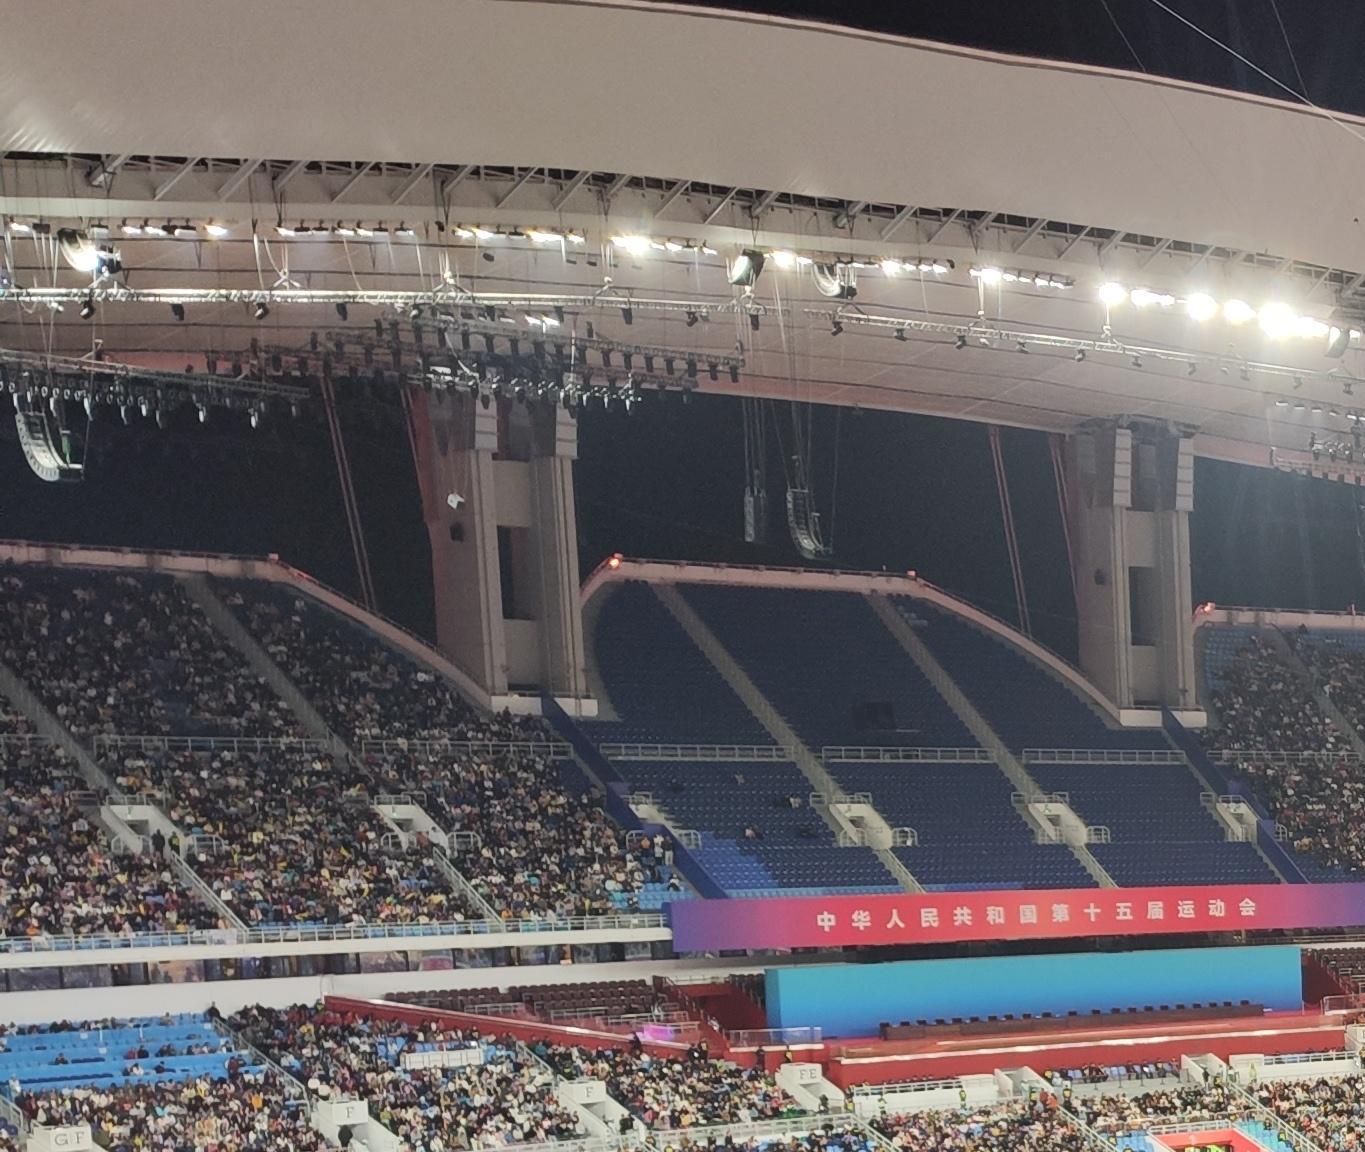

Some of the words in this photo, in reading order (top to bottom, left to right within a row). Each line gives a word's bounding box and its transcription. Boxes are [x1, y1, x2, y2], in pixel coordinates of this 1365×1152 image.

[817, 897, 1257, 932] 中华人民共和国第十五届运动会
[585, 1086, 594, 1097] F
[346, 1106, 354, 1118] F
